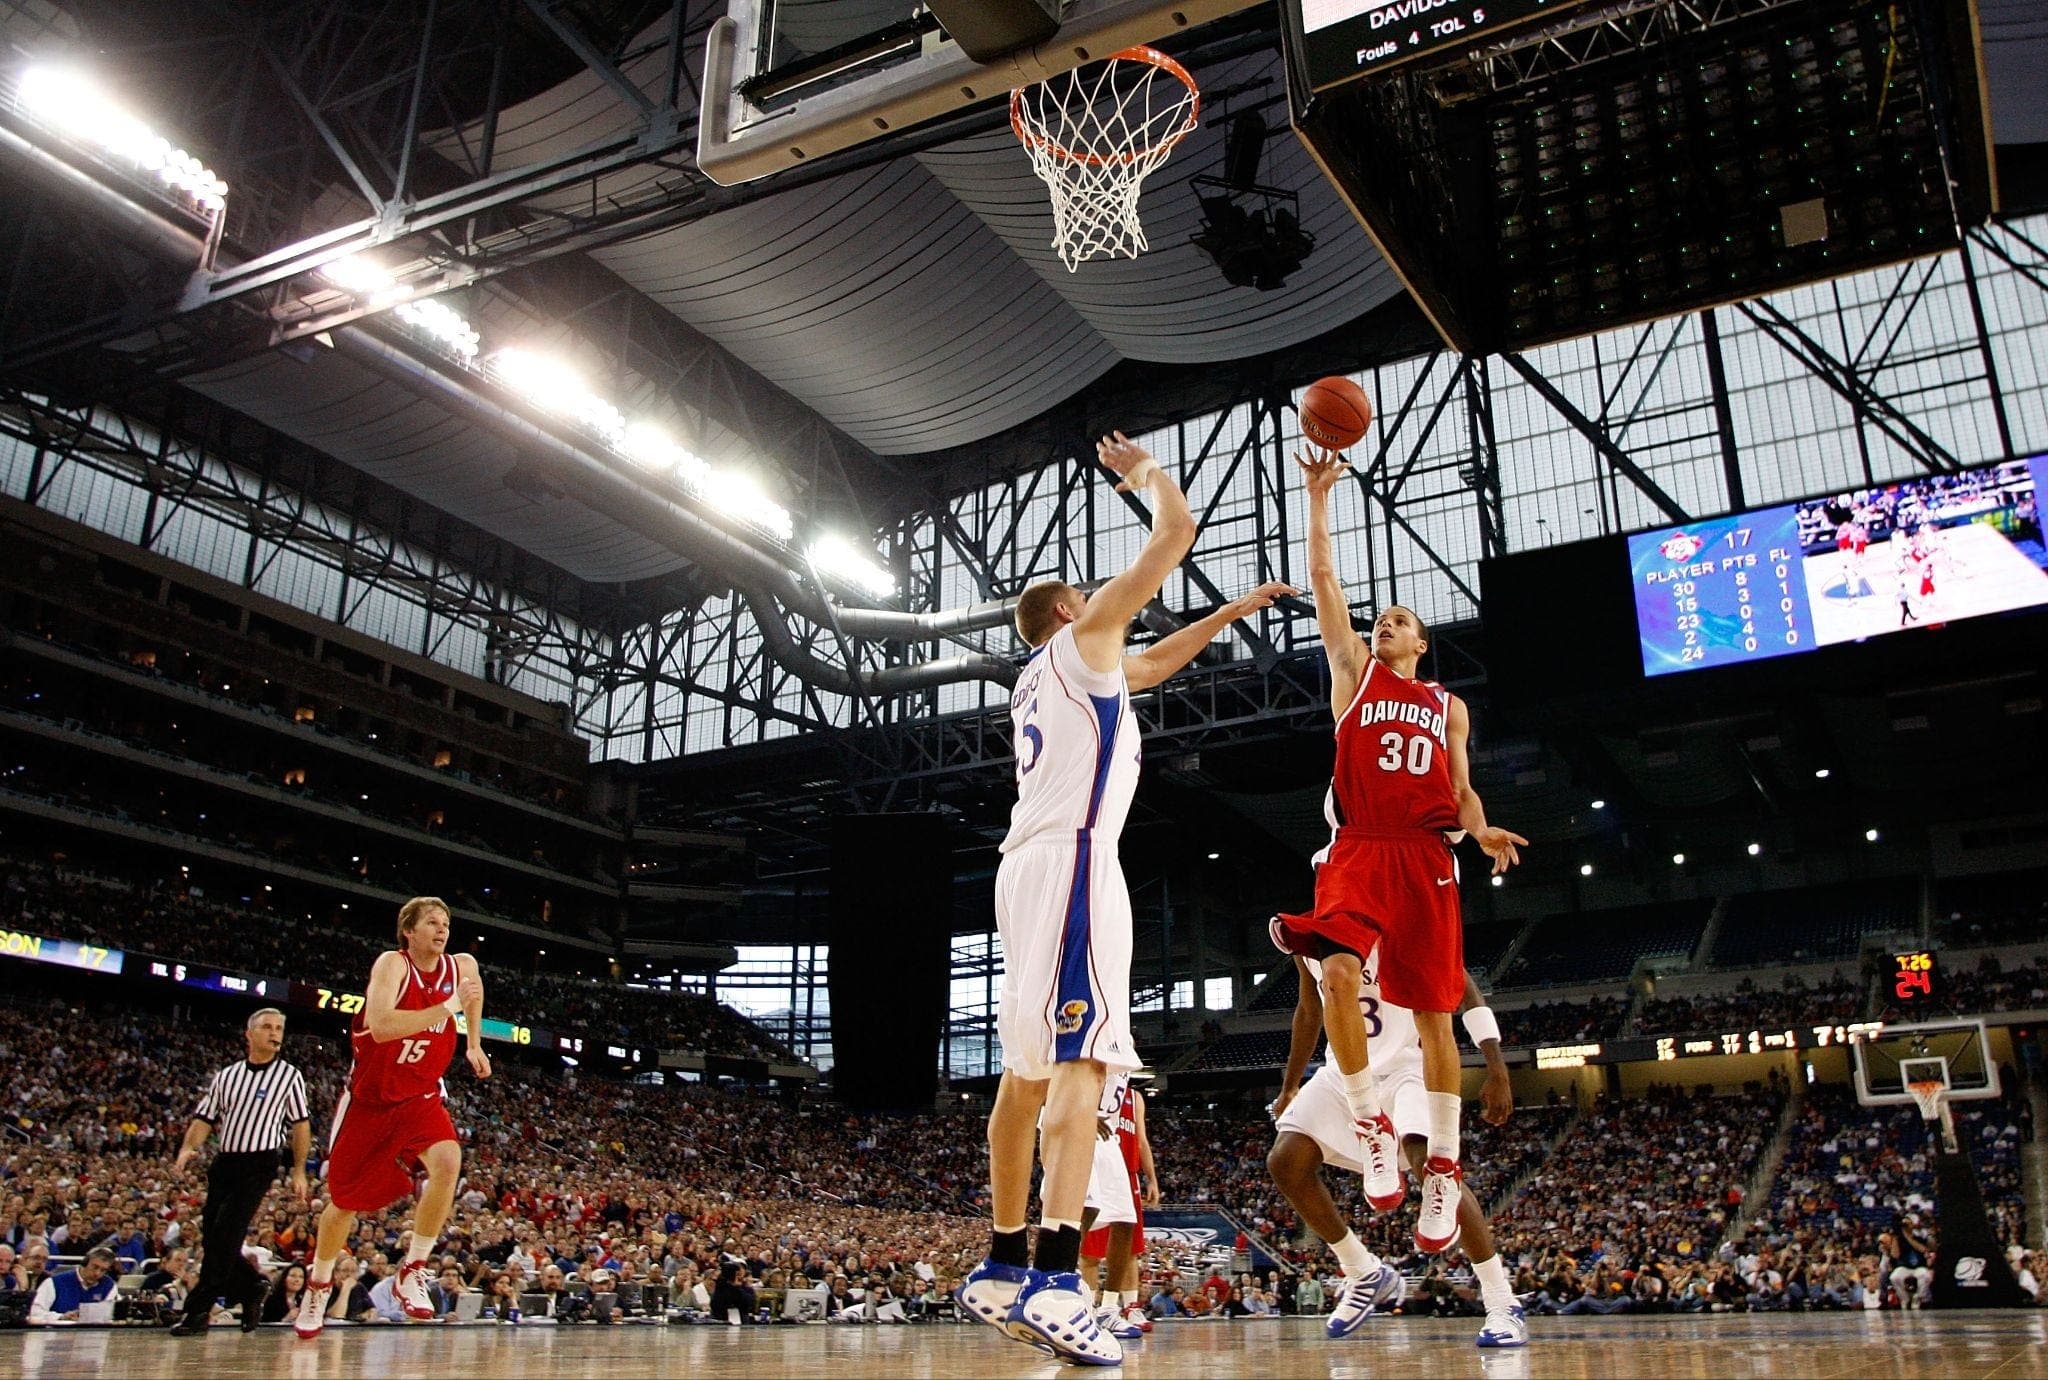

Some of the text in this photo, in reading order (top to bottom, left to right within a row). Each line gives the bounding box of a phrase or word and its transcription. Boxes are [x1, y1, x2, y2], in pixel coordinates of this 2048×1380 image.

[1369, 0, 1457, 29] DAVID
[1357, 8, 1486, 64] Fouls 4 TOL 5
[1724, 528, 1752, 549] 17
[1646, 549, 1792, 584] PLAYER PTS FL
[1672, 564, 1787, 597] 30 8 0
[1676, 581, 1789, 613] 15 3 1
[1677, 597, 1793, 630] 23 0 0
[1684, 614, 1794, 645] 2 4 1
[1681, 630, 1798, 662] 24 0 0
[1016, 697, 1044, 776] 5
[1378, 732, 1433, 775] 30
[78, 944, 109, 968] 17
[1896, 953, 1933, 971] 7:26
[174, 964, 187, 981] 5
[256, 980, 267, 996] 4
[1895, 971, 1931, 998] 24
[317, 988, 366, 1014] 7:27
[511, 1026, 531, 1045] 16
[574, 1038, 583, 1052] 5
[632, 1049, 641, 1062] 6
[397, 1039, 431, 1064] 15
